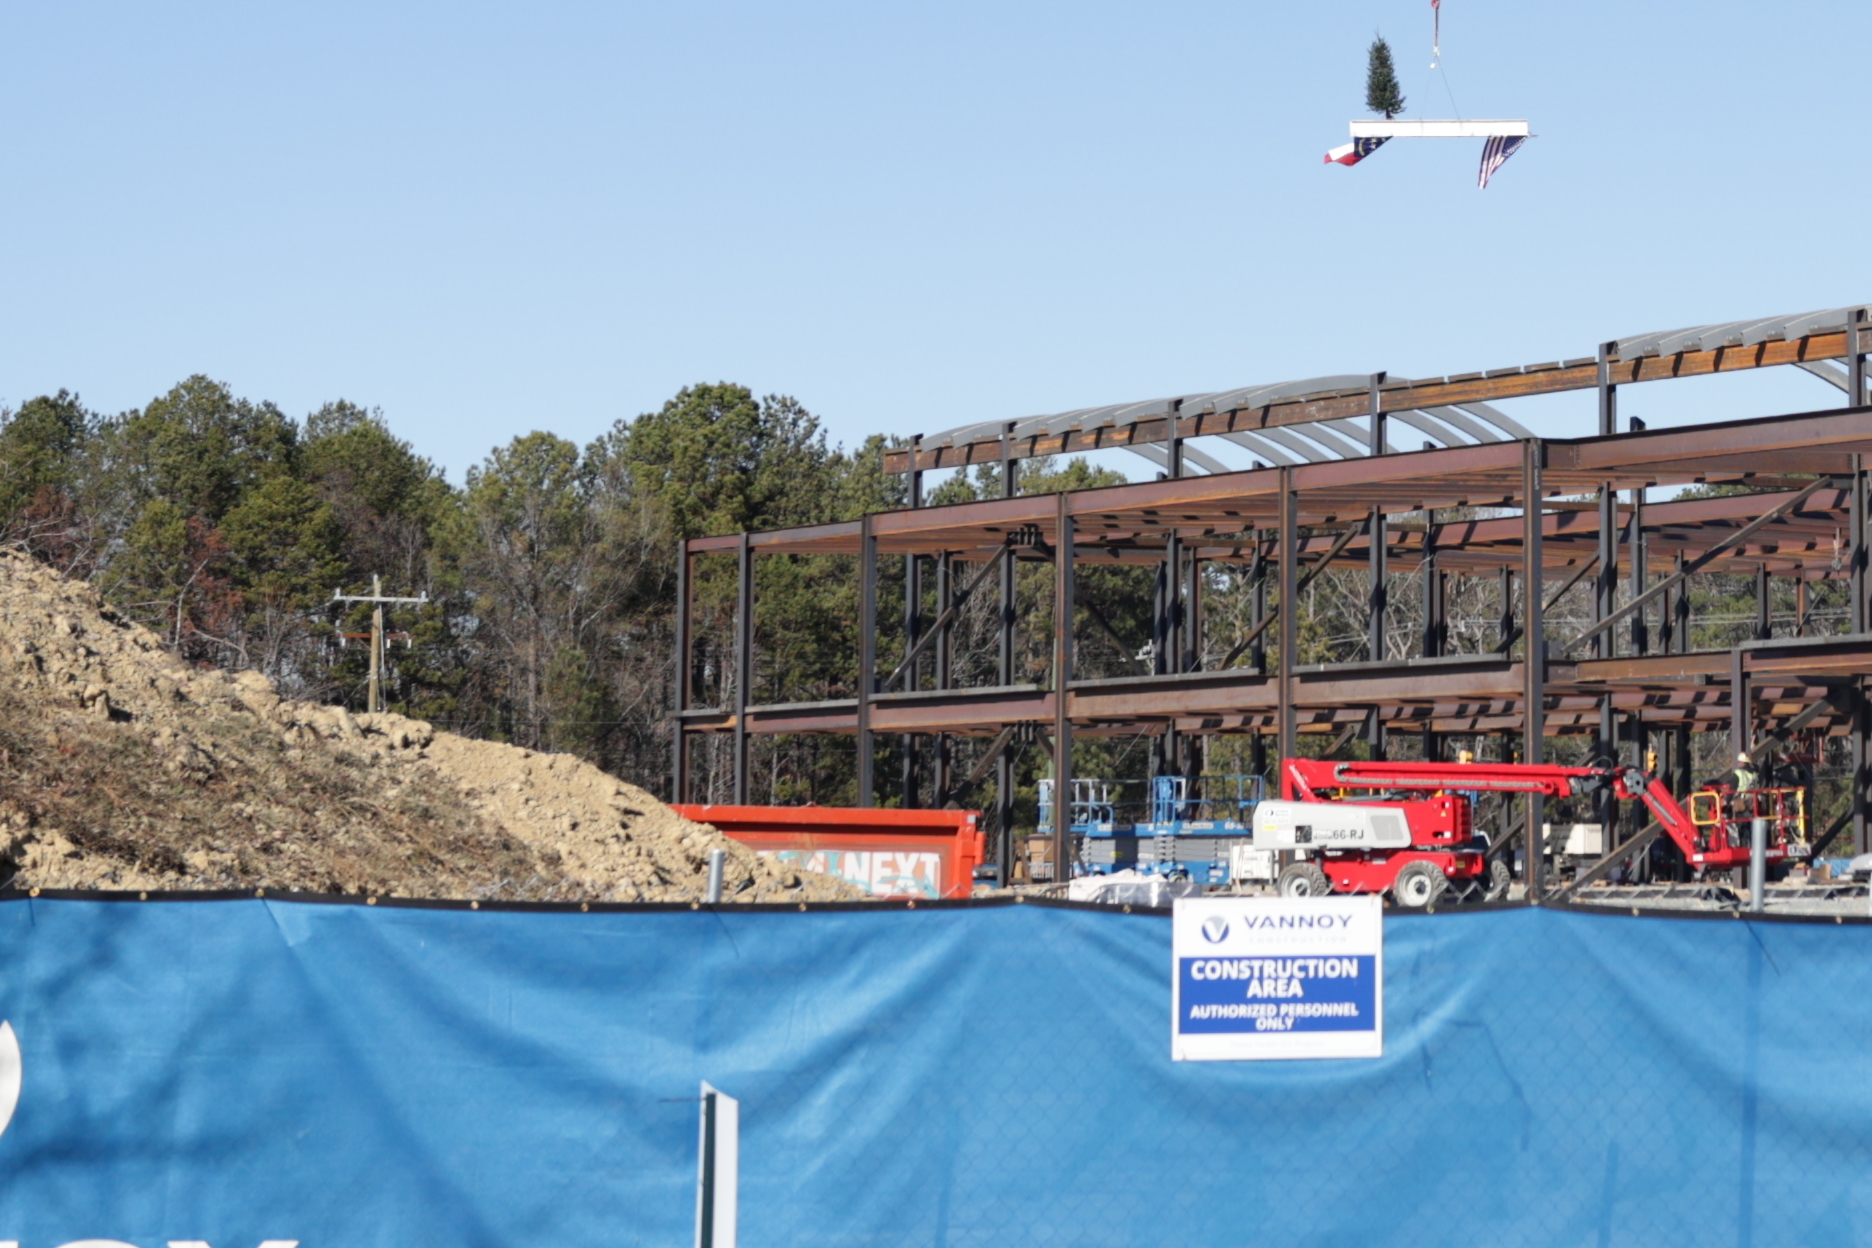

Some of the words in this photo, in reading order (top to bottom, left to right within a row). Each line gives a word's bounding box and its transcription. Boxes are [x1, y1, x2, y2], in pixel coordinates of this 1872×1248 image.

[1244, 914, 1353, 929] VANNOY
[1190, 958, 1359, 980] CONSTRUCTION
[1246, 978, 1304, 999] AREA
[1190, 1003, 1277, 1020] AUTHORIZED
[1279, 1001, 1359, 1019] PERSONNEL
[1255, 1016, 1294, 1031] ONLY
